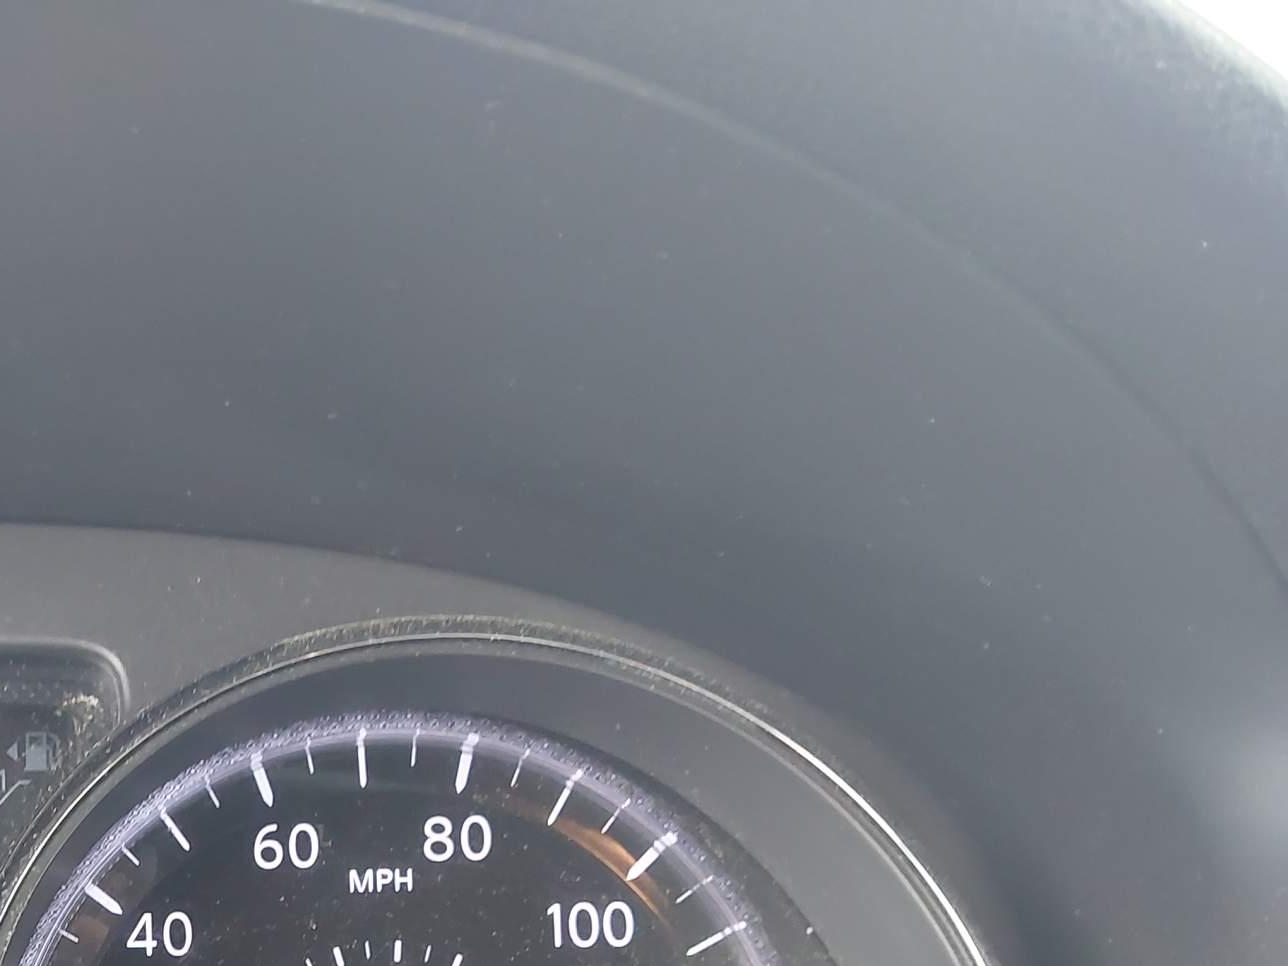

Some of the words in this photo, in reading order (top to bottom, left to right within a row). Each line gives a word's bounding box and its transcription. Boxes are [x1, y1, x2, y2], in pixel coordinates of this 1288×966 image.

[253, 823, 320, 869] 60
[423, 815, 492, 862] 80
[349, 868, 413, 893] MPH
[126, 912, 193, 956] 40
[548, 902, 635, 948] 100
